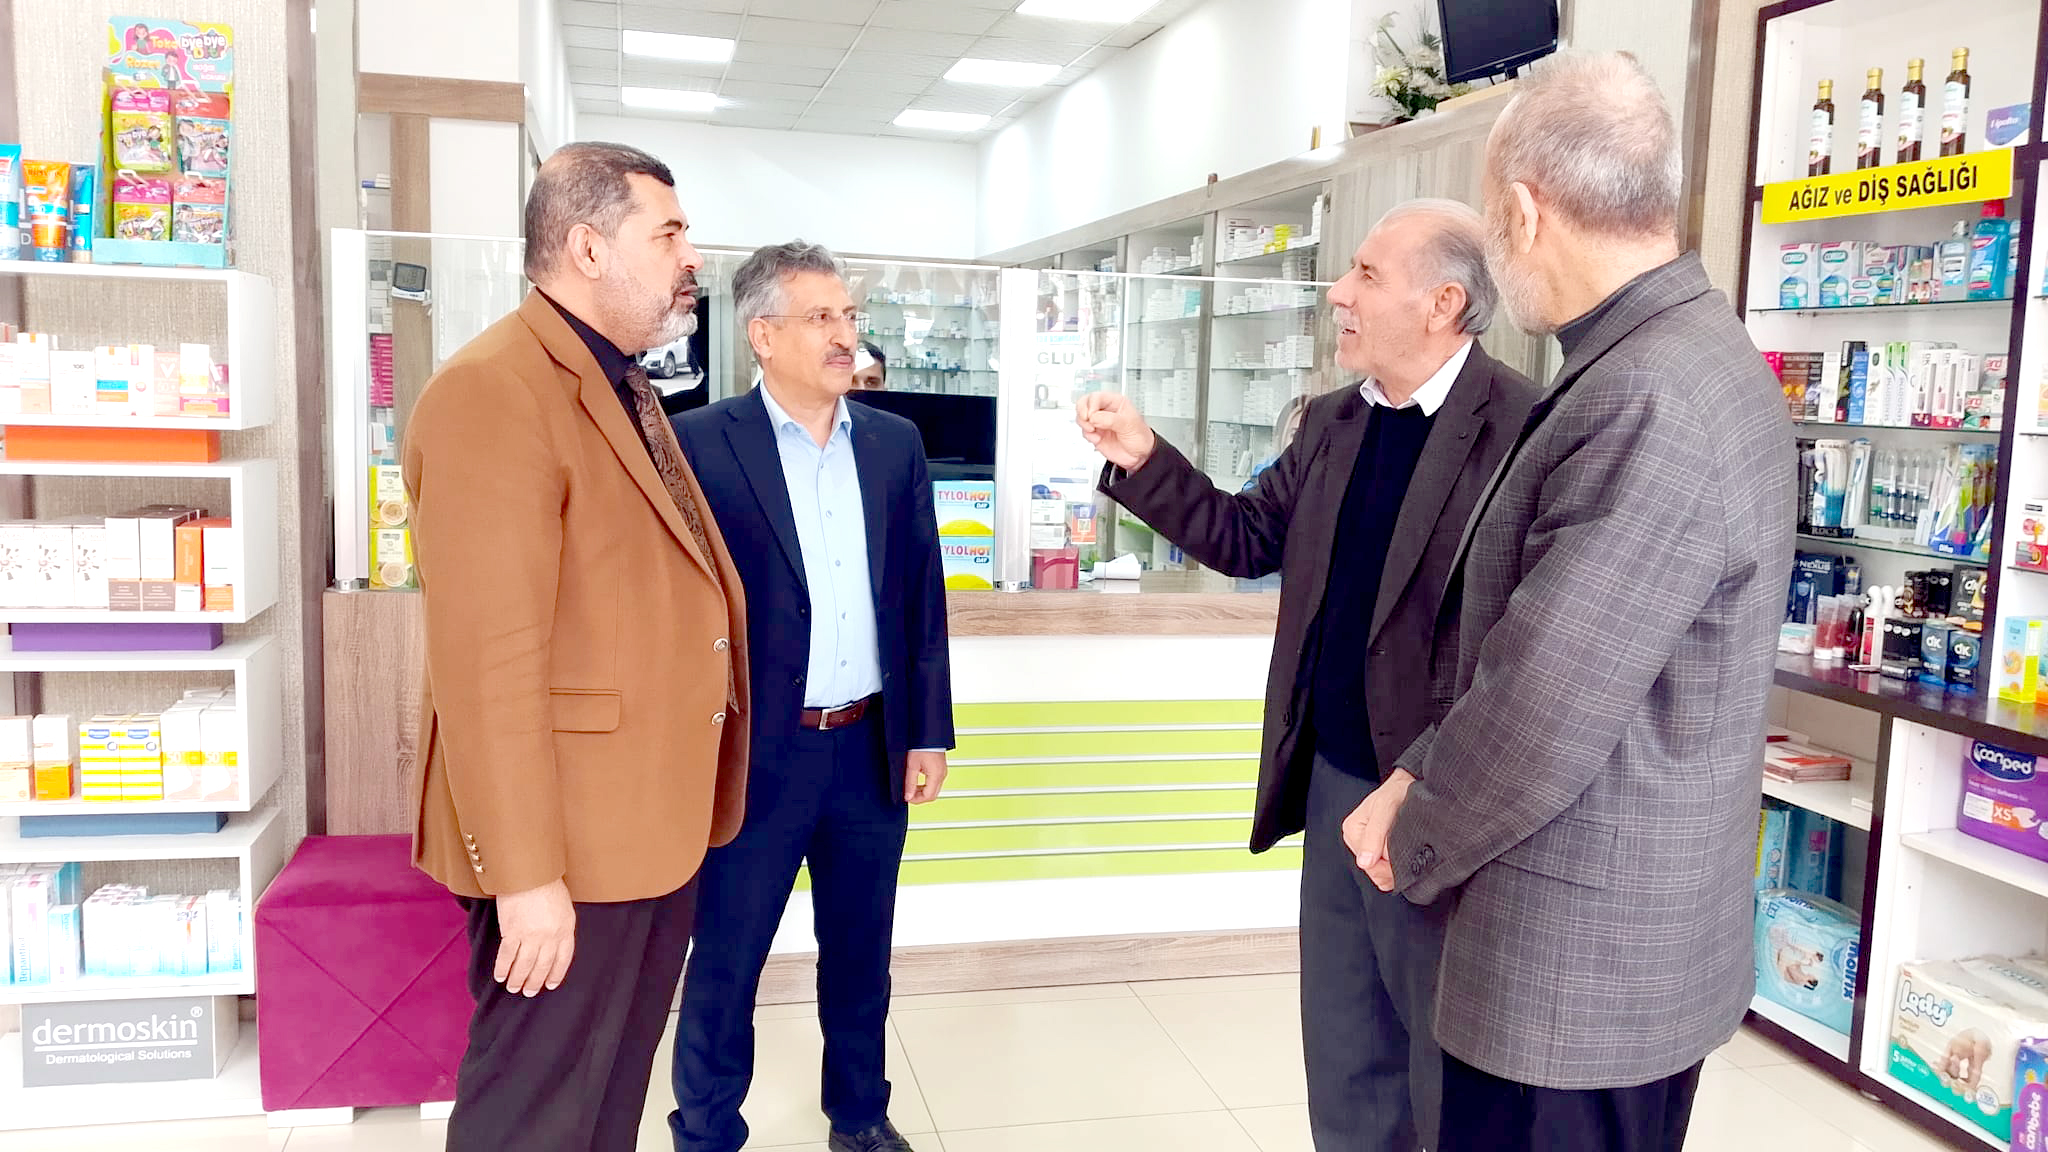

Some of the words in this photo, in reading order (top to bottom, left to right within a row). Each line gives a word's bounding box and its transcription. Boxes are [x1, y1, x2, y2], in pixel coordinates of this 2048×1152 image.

[1789, 184, 1829, 211] AĞIZ
[1834, 188, 1852, 205] ve
[1858, 174, 1889, 206] DİŞ
[1896, 161, 1977, 198] SAĞLIĞI
[1994, 805, 2012, 821] XS
[46, 1049, 135, 1065] Dermatological
[137, 1049, 192, 1061] Solutions
[1892, 1049, 1900, 1062] 5
